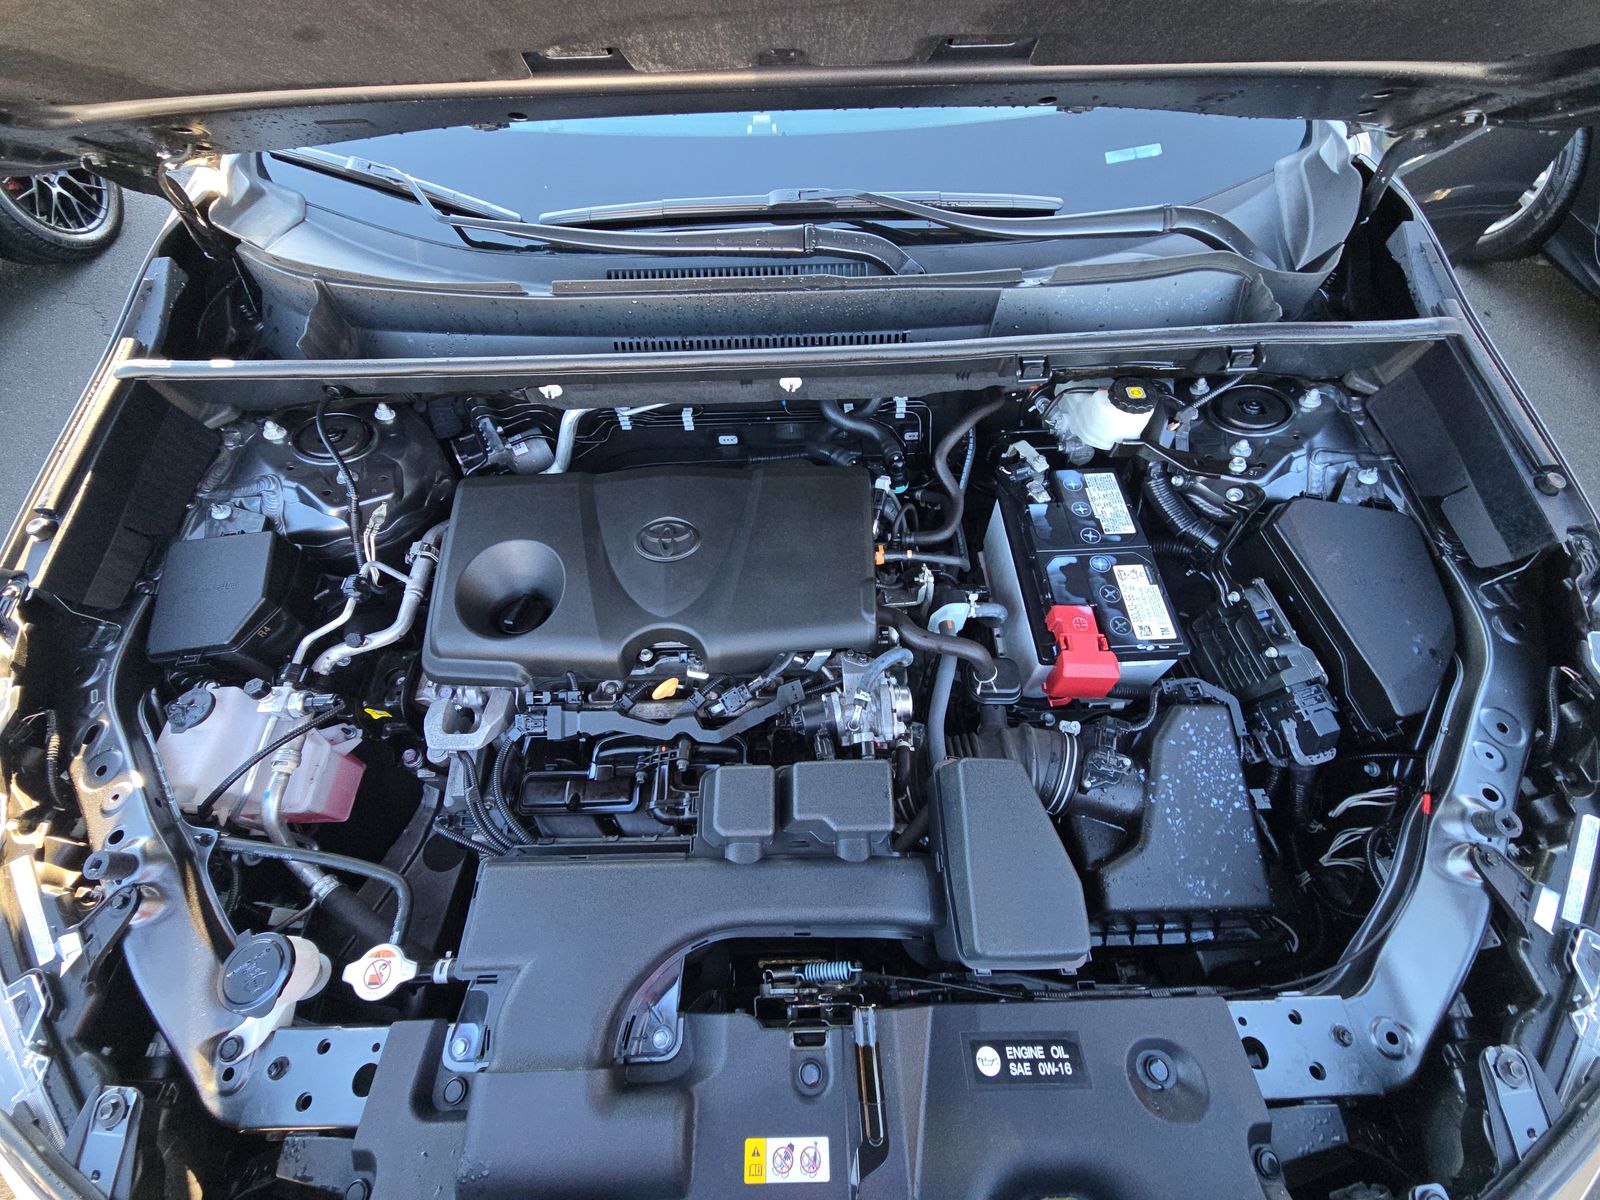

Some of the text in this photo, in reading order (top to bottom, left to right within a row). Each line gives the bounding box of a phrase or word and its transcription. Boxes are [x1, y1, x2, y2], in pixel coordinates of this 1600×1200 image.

[1005, 1045, 1070, 1060] ENGINE OIL
[1009, 1062, 1073, 1076] SAE 0W-16
